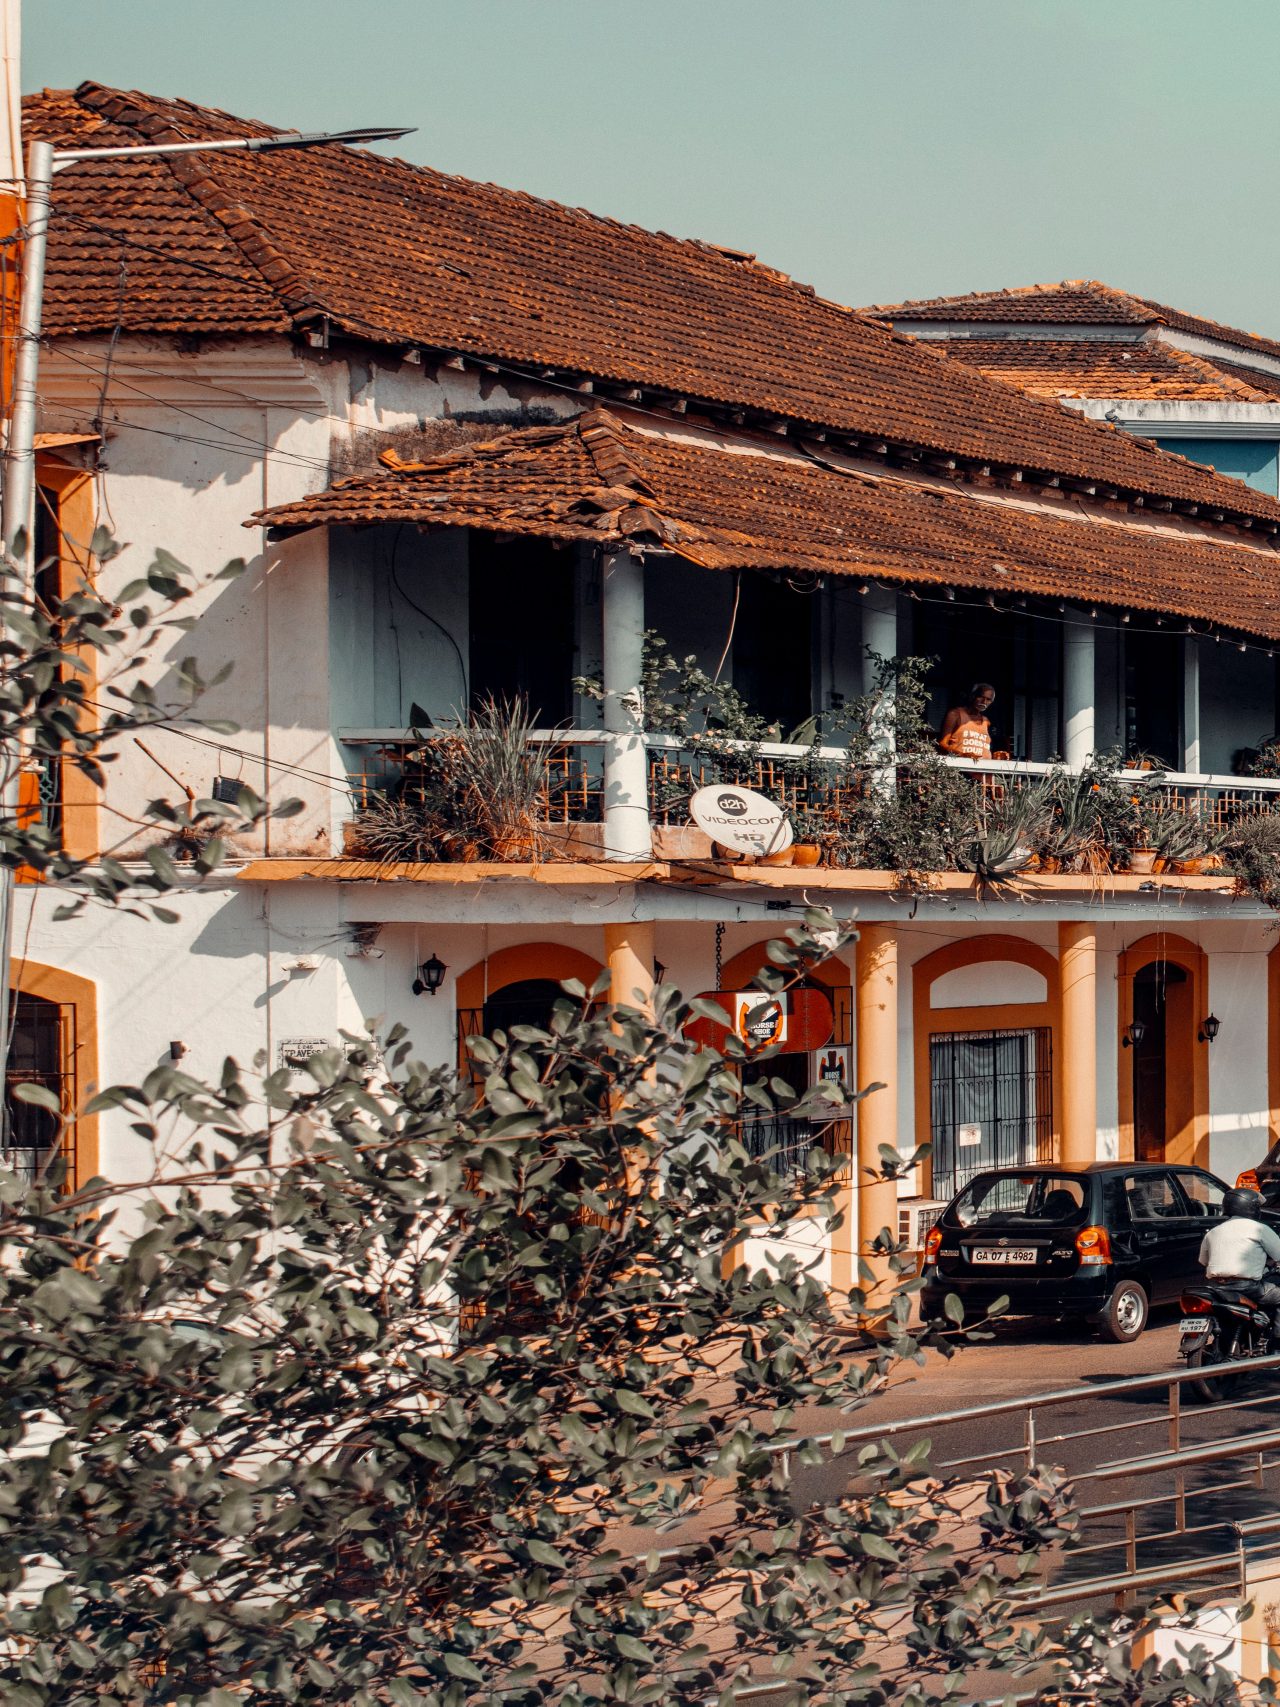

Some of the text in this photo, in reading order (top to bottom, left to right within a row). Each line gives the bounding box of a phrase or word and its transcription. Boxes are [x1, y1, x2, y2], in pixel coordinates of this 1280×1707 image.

[962, 746, 983, 756] TOUR
[720, 799, 746, 809] d2h
[701, 814, 780, 825] VIDEOCON
[733, 833, 766, 842] HD
[976, 1251, 988, 1261] GA
[991, 1251, 1003, 1261] 07
[1012, 1251, 1034, 1261] 4982
